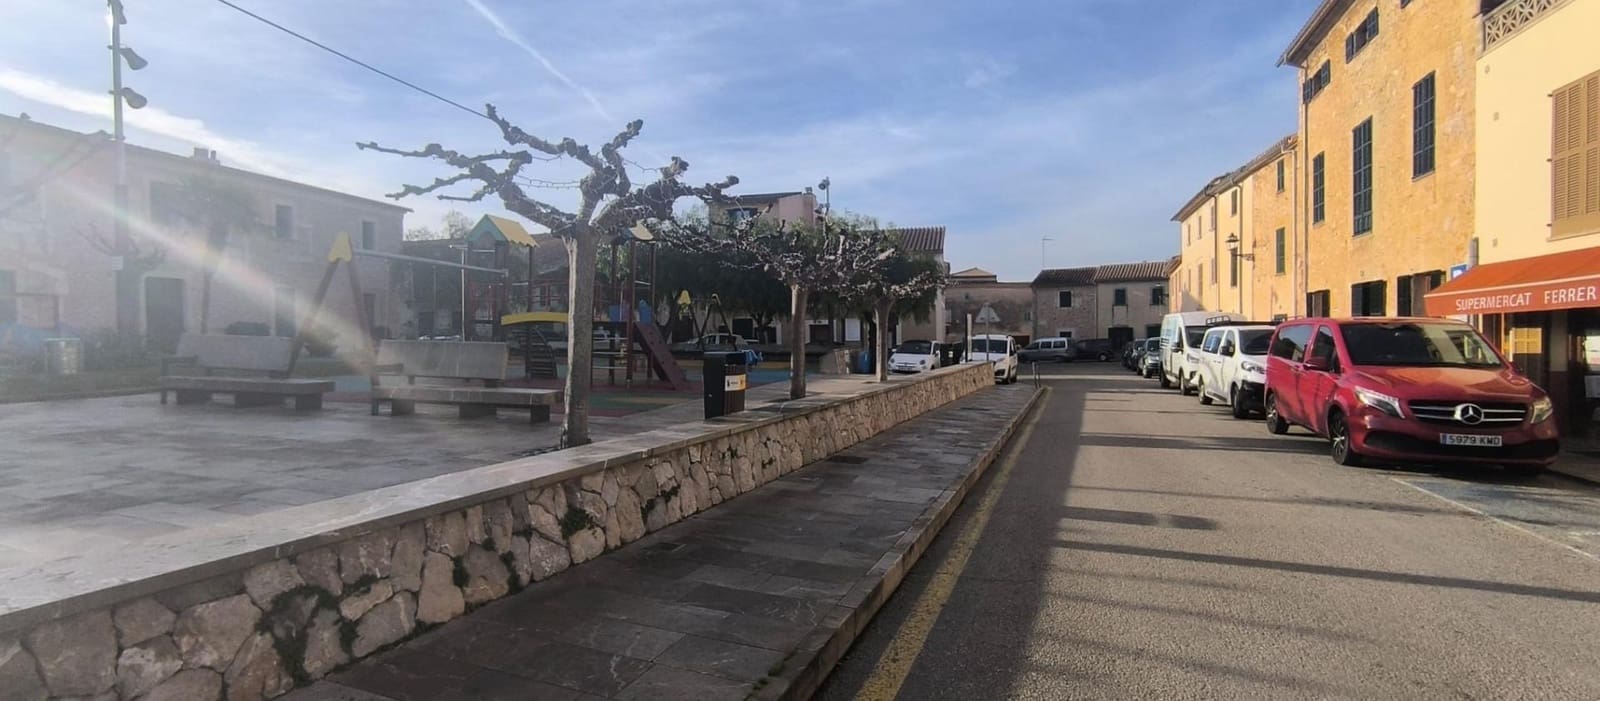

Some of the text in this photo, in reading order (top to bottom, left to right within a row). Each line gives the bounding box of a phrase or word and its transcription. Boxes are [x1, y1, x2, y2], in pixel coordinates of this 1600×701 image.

[1455, 286, 1597, 311] SUPERMERCAT FERRER
[1448, 435, 1476, 444] 5979
